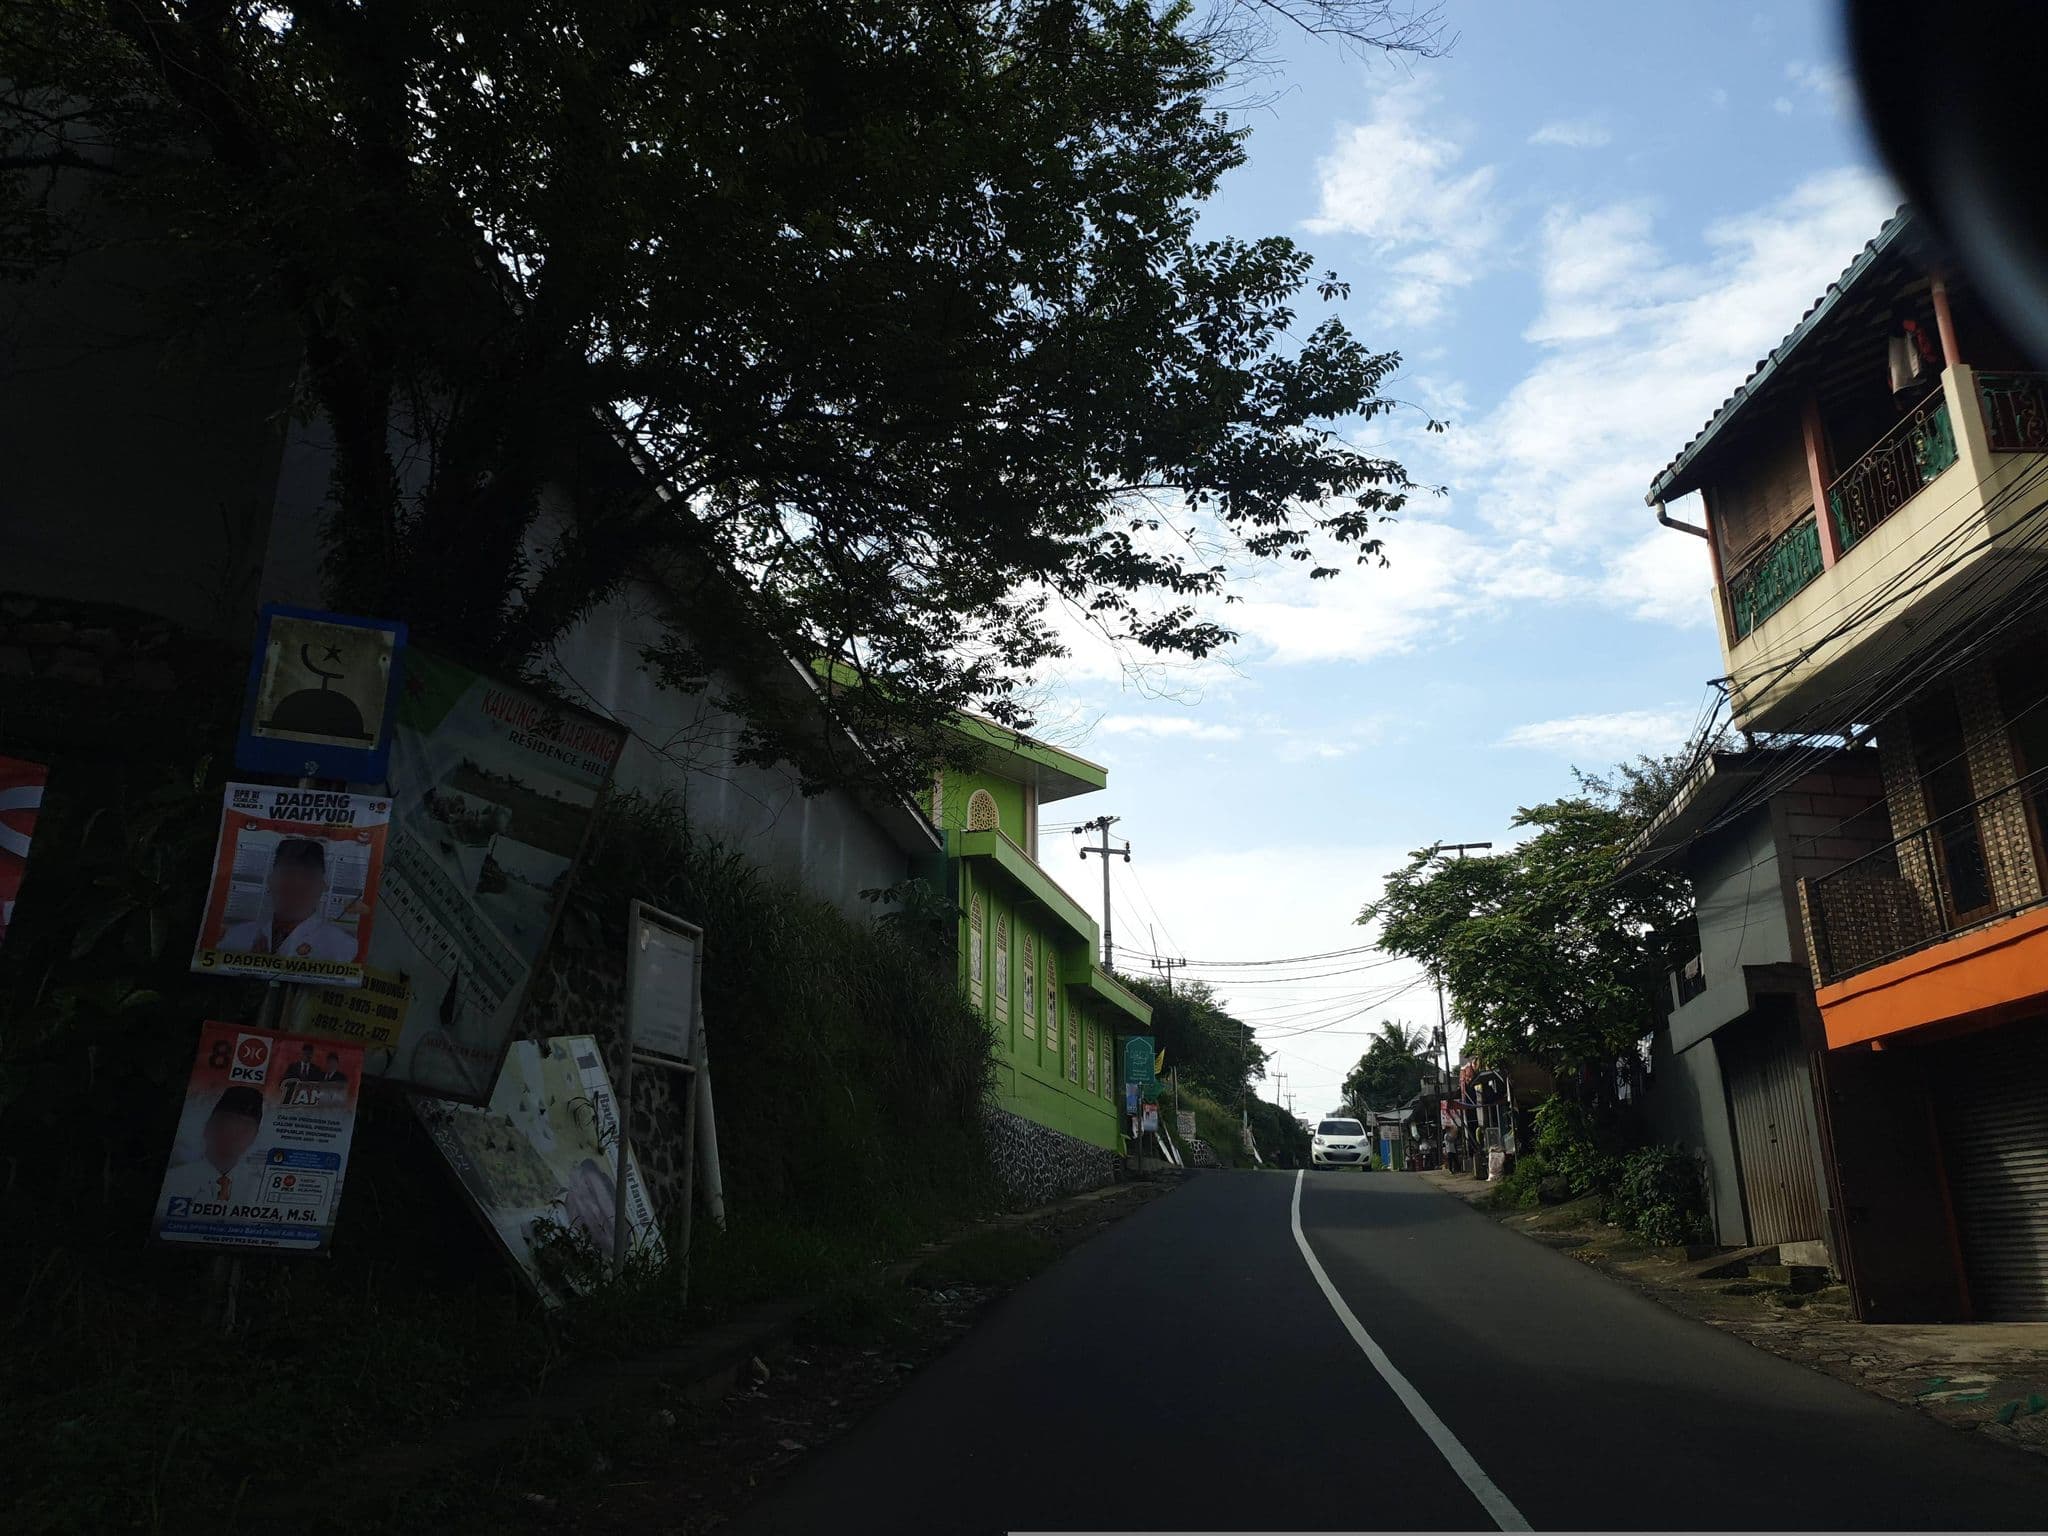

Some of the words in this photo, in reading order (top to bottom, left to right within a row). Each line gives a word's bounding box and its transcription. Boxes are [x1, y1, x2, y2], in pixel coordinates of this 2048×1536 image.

[481, 688, 538, 729] KAVLING
[509, 731, 577, 766] RESIDENCE
[275, 793, 351, 809] DADENG
[368, 802, 375, 811] 8
[269, 806, 356, 823] WAHYUDI
[202, 952, 215, 967] 5
[223, 953, 281, 969] DADENG
[286, 959, 351, 976] WAHYUDI
[209, 1040, 231, 1069] 8
[231, 1067, 264, 1081] PKS
[272, 1176, 282, 1188] 8
[175, 1200, 187, 1216] 2
[192, 1202, 227, 1217] DEDI
[230, 1205, 283, 1222] AROZA,
[286, 1208, 318, 1222] M.Si.
